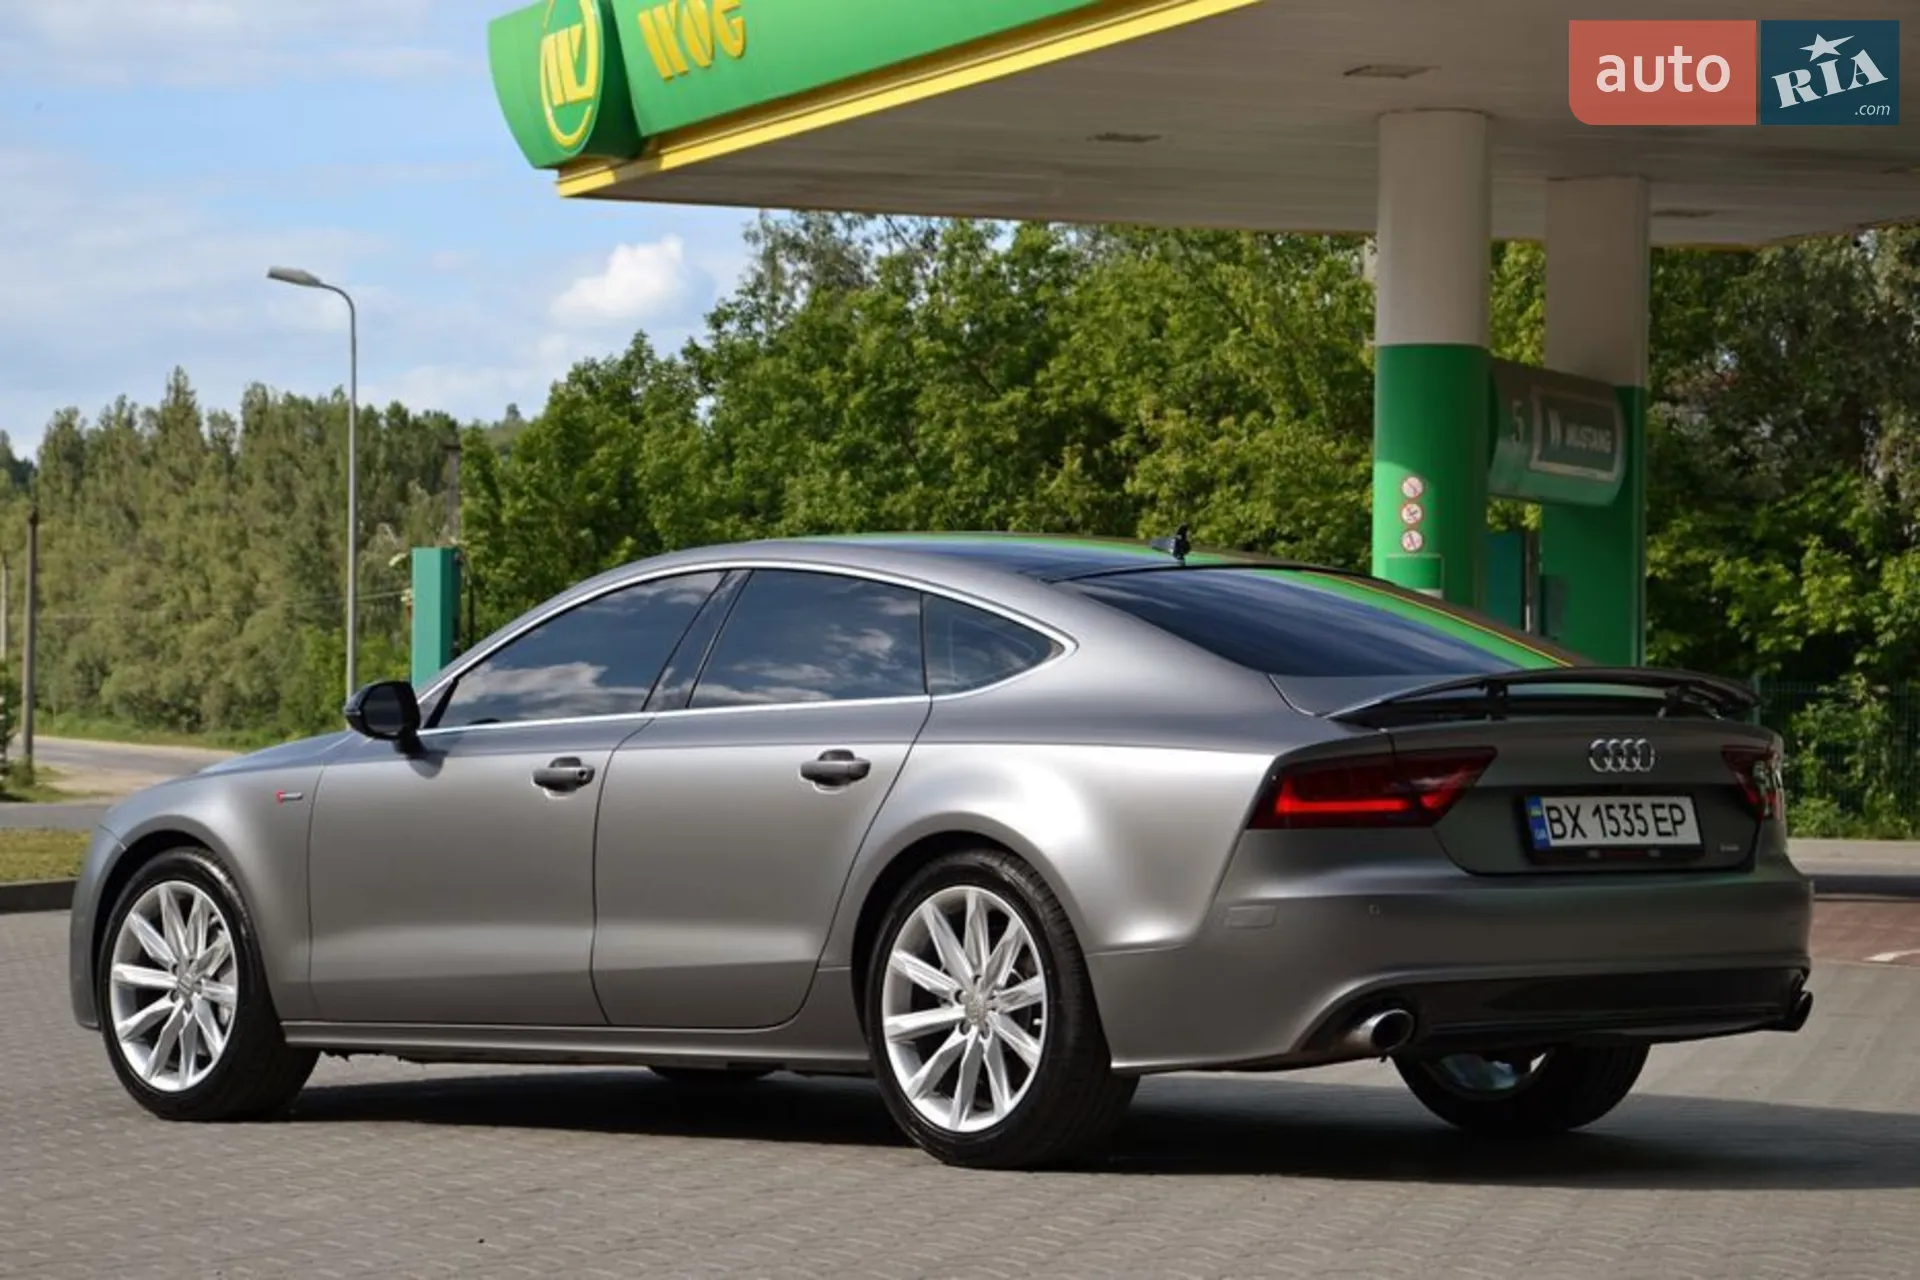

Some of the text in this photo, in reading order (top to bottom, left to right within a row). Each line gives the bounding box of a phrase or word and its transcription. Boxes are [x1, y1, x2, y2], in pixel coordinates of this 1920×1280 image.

[1546, 803, 1686, 840] BX 1535 EP
